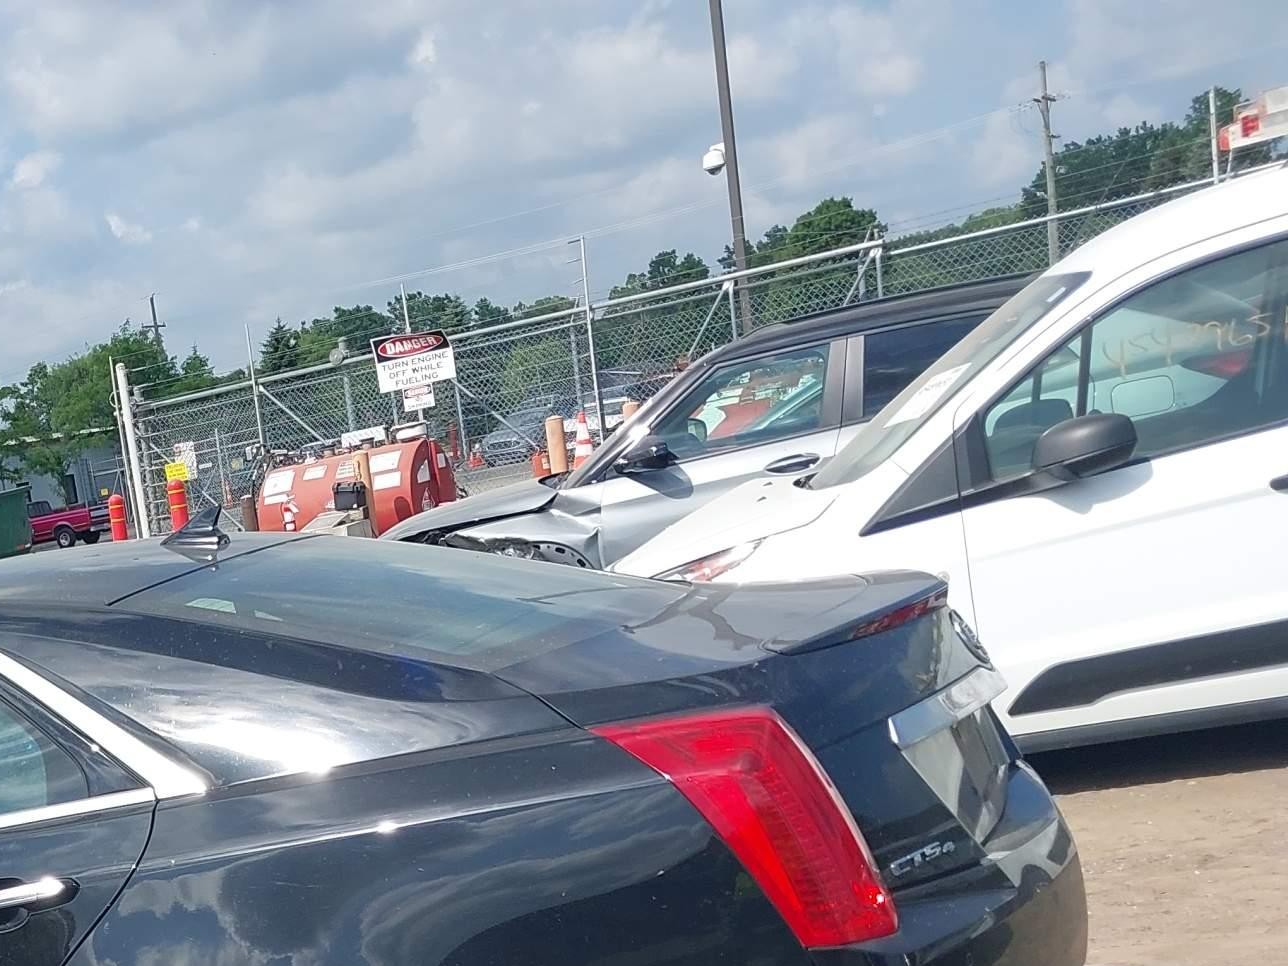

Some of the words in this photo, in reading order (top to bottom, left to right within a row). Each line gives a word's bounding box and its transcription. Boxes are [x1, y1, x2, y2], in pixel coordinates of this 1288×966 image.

[385, 336, 437, 354] DANGER
[382, 360, 408, 371] TURN
[412, 351, 448, 364] ENGINE
[388, 369, 408, 380] OFF
[412, 361, 444, 374] WHILE
[395, 371, 439, 387] FUELING
